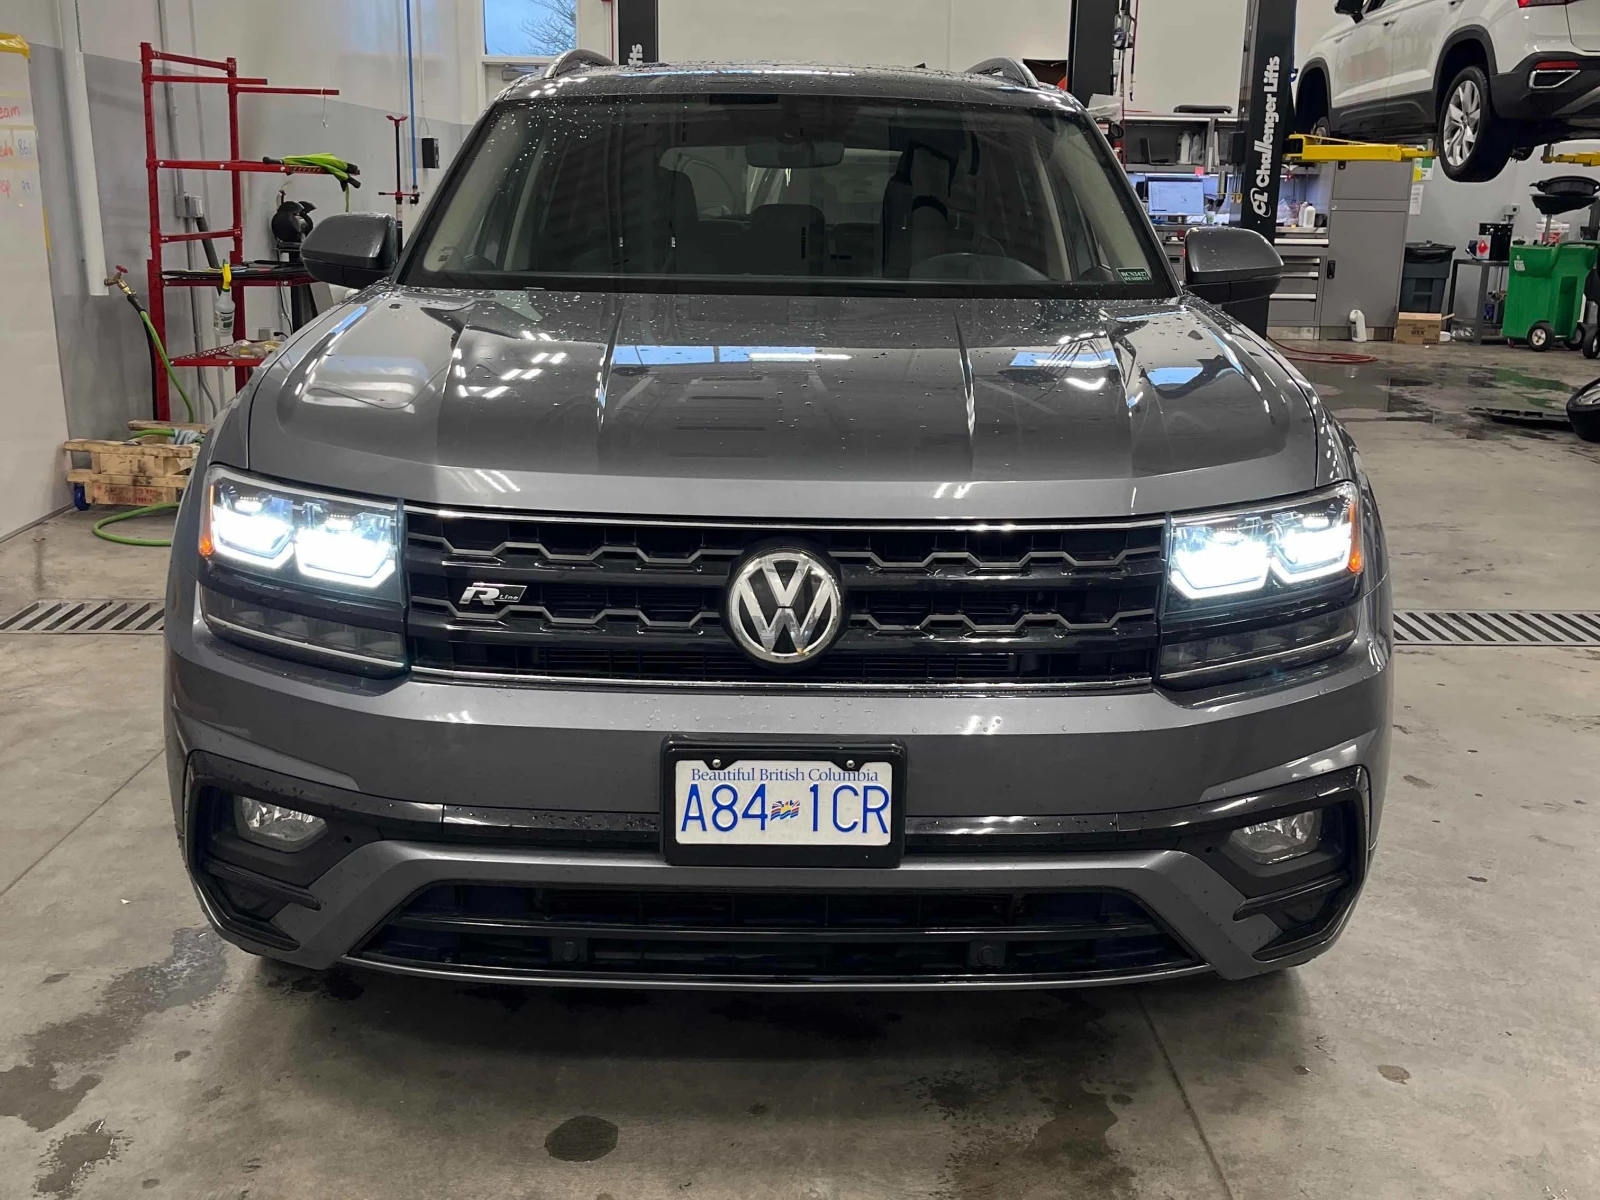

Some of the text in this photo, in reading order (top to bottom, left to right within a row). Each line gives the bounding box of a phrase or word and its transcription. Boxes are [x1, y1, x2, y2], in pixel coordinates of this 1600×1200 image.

[1263, 55, 1280, 92] Lifts
[458, 586, 500, 605] R
[691, 767, 879, 783] Beautiful British Columbia
[681, 783, 890, 834] A84 1CR
